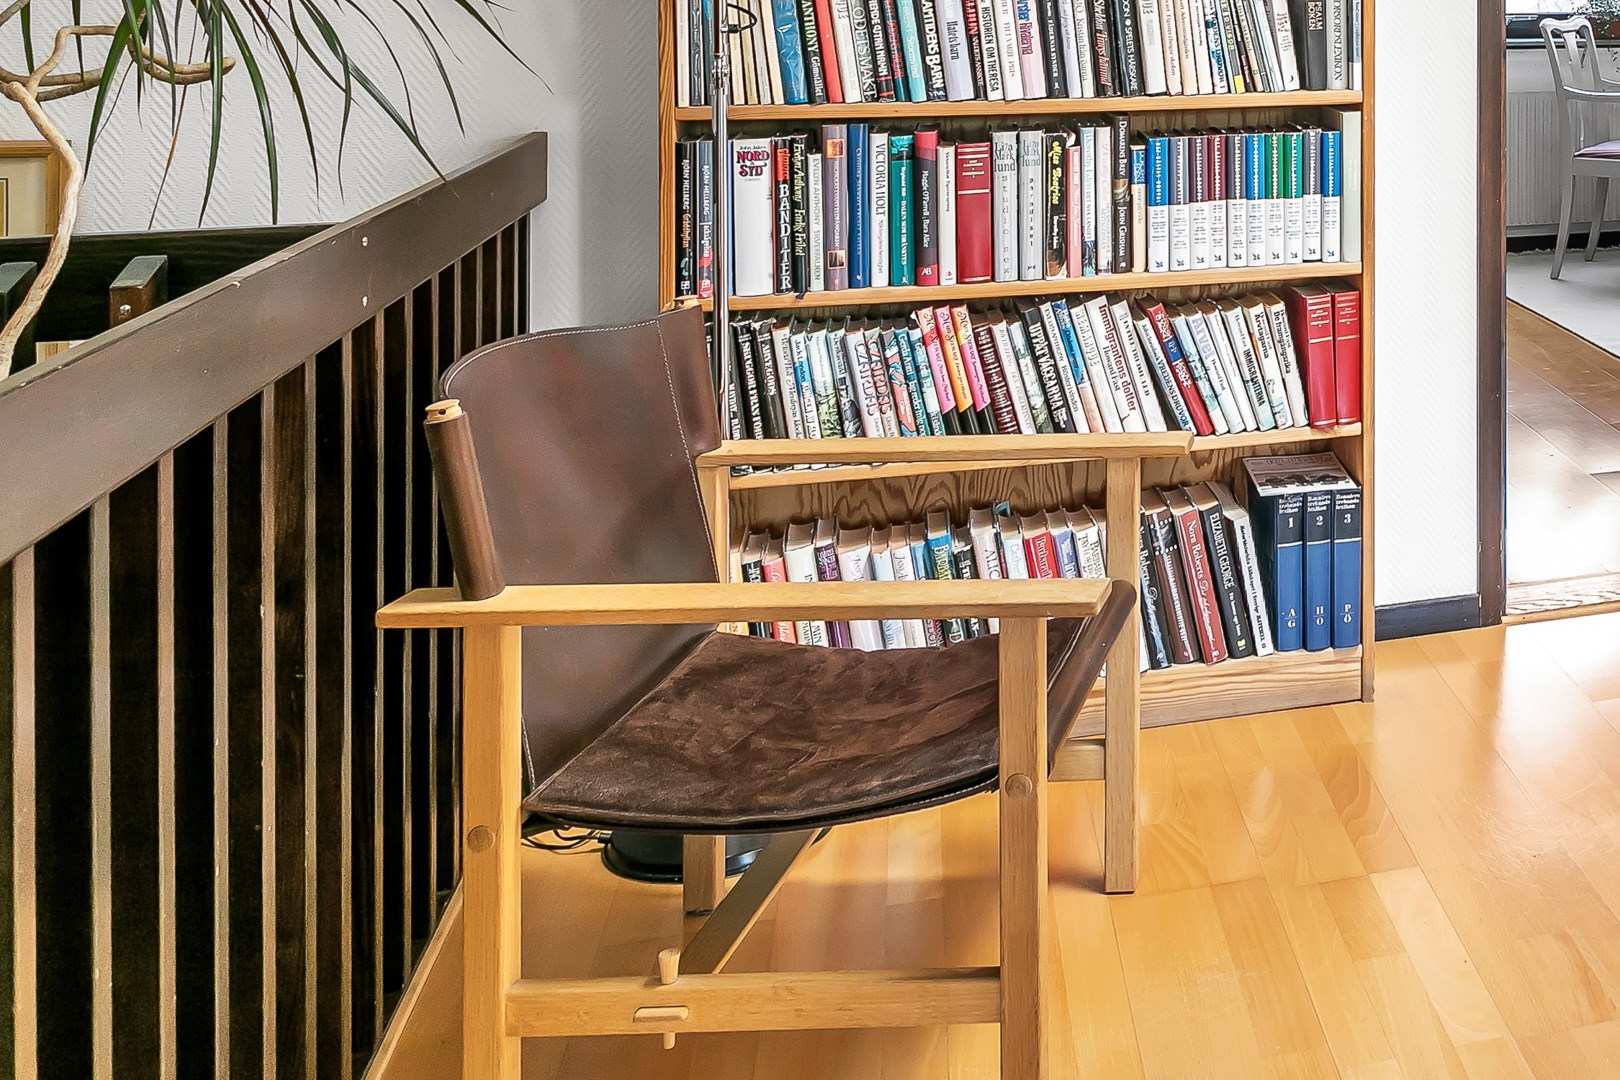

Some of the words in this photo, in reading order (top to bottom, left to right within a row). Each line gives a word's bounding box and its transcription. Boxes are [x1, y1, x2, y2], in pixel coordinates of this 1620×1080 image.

[801, 1, 819, 52] ANTHONY
[981, 7, 994, 45] HISTORIEN
[1091, 0, 1105, 30] Sheldon
[1315, 1, 1323, 30] PSALM
[874, 49, 888, 76] NAMN
[986, 46, 996, 59] OM
[925, 55, 944, 88] BARN
[987, 60, 999, 92] THERESA
[682, 159, 690, 178] BJÖRN
[736, 150, 770, 164] NORD
[739, 165, 764, 177] SYD
[875, 143, 886, 190] VICTORIA
[1119, 159, 1127, 176] BREV
[702, 165, 710, 184] BJÖRN
[792, 170, 805, 202] Anthony
[875, 191, 886, 217] HOLT
[1118, 206, 1127, 225] JOHN
[778, 184, 792, 290] BANDITER
[1119, 226, 1127, 256] GRISHAM
[898, 334, 909, 357] Gerda
[762, 343, 776, 396] ARVEGODS
[797, 356, 807, 383] London
[1102, 346, 1117, 375] Howard
[1111, 376, 1121, 392] Fast
[1242, 348, 1265, 407] IMMIGRANTERNA
[1122, 380, 1136, 412] dotter
[1169, 394, 1187, 427] DRUVOR
[1288, 517, 1294, 528] 1
[1316, 515, 1323, 527] 2
[1344, 513, 1351, 525] 3
[1187, 520, 1197, 543] Nora
[1192, 545, 1205, 579] Roberts
[1210, 512, 1226, 555] ELIZABETH
[1219, 556, 1234, 589] GEORGE
[1288, 608, 1296, 617] A
[1288, 618, 1296, 629] G
